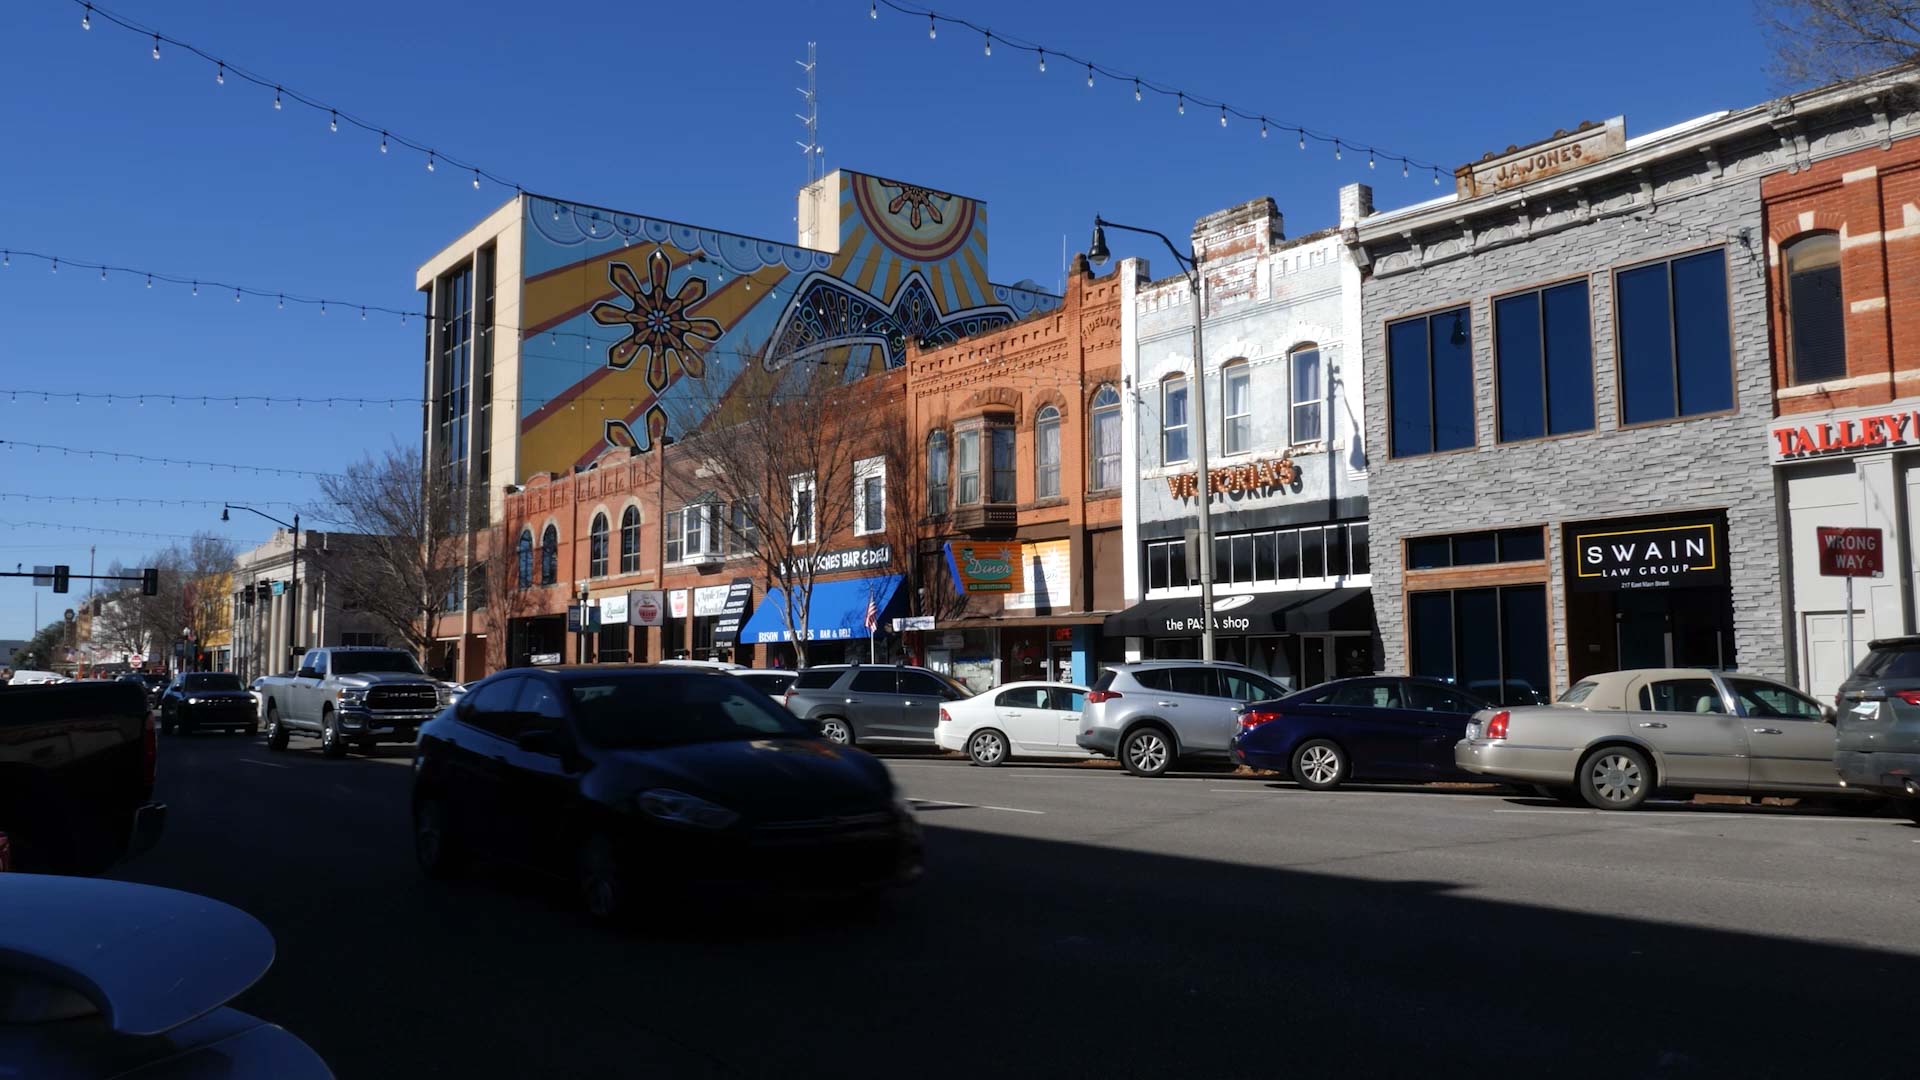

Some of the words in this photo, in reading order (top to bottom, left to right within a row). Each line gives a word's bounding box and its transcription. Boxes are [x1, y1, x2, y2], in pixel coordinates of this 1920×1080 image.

[1773, 410, 1920, 454] TALLEY
[1167, 457, 1295, 501] VICTORIA'S
[1587, 538, 1704, 564] SWAIN
[1824, 535, 1876, 551] WRONG
[842, 550, 860, 568] BAR
[861, 549, 869, 566] &
[869, 546, 889, 565] DELI
[1836, 554, 1866, 568] WAY
[967, 557, 1010, 574] Diner
[1602, 567, 1631, 577] LAW
[1639, 564, 1689, 576] GROUP
[1166, 618, 1184, 631] the
[1187, 617, 1219, 630] PASA
[1222, 615, 1250, 631] shop
[758, 631, 779, 643] BISON
[819, 629, 831, 639] BAR
